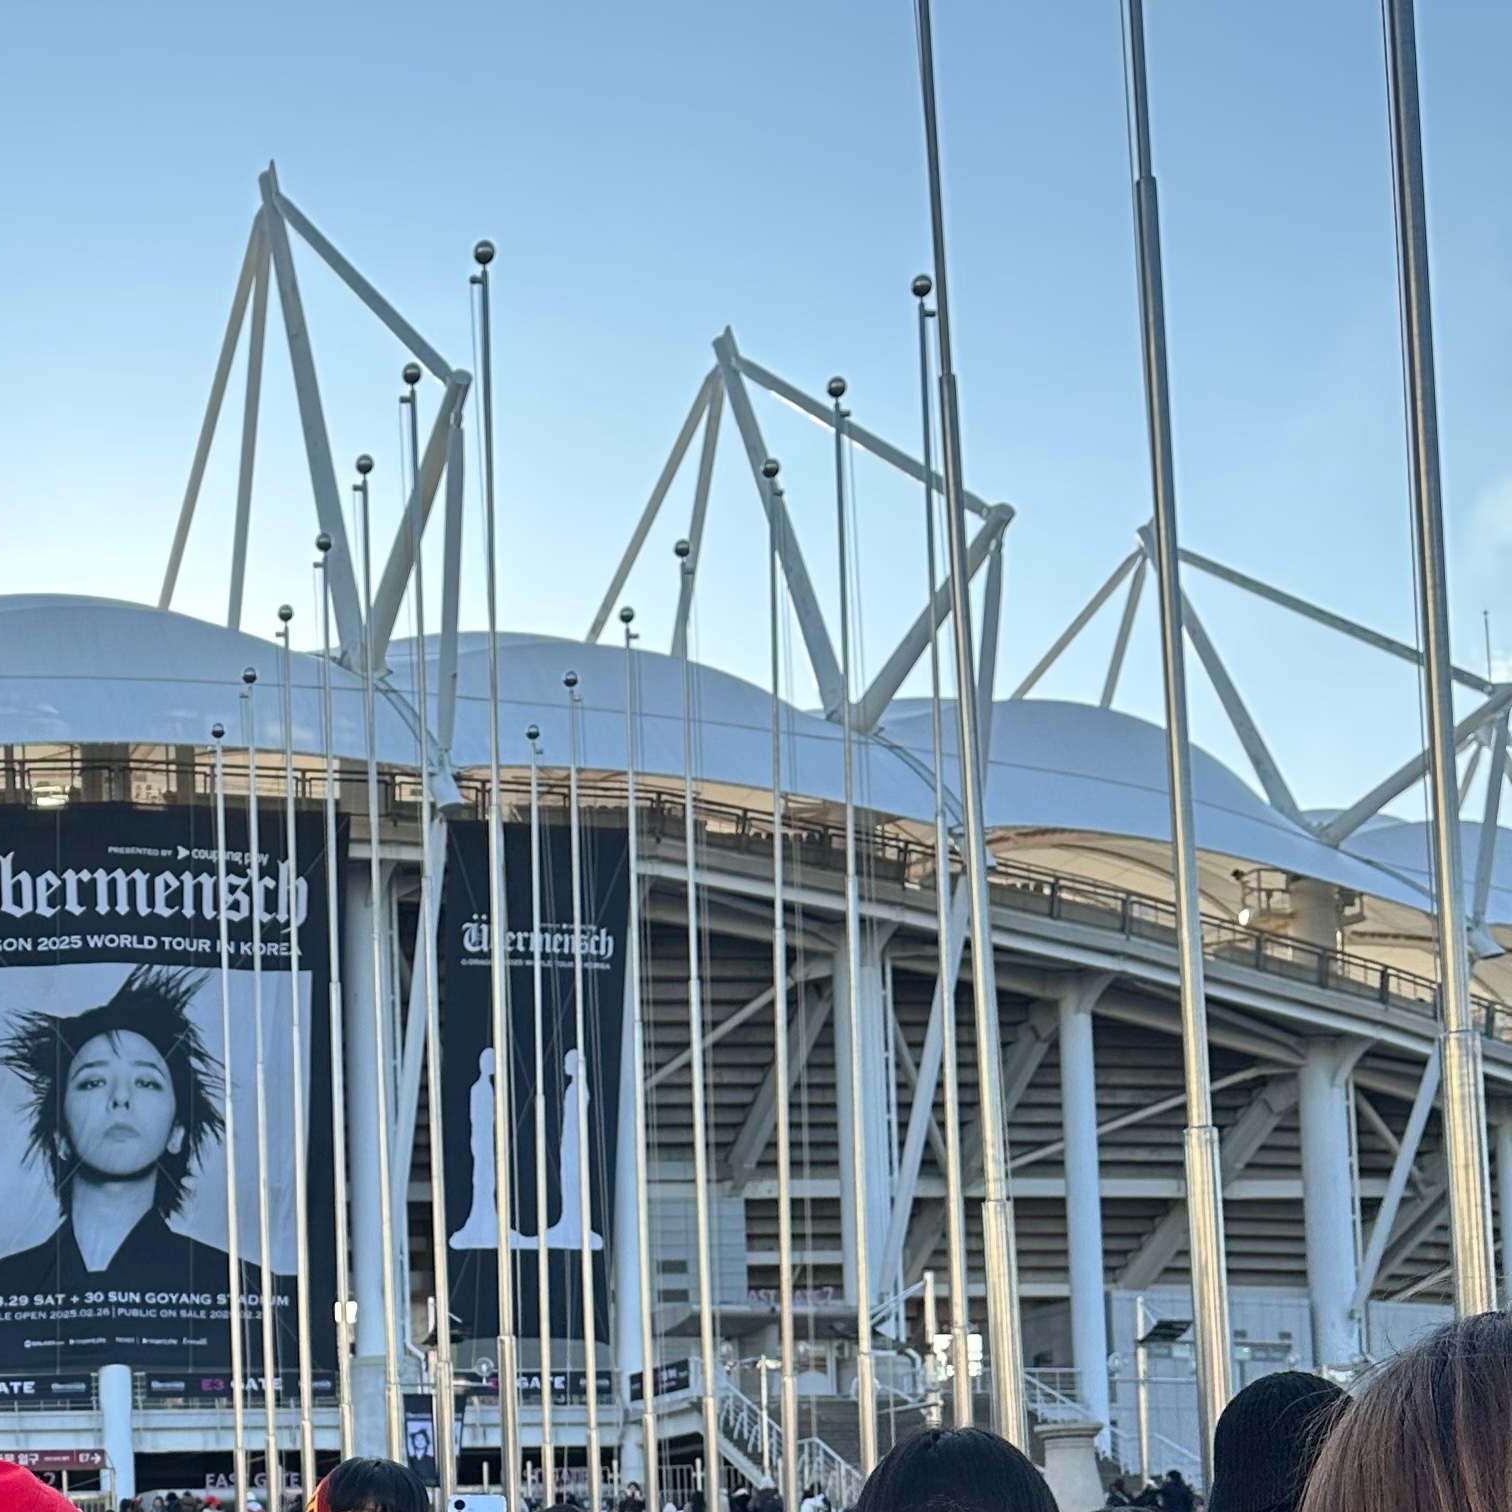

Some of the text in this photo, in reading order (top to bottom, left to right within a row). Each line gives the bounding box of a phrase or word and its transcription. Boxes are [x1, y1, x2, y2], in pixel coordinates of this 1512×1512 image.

[37, 935, 82, 951] 2025
[86, 934, 158, 949] WORLD
[160, 936, 211, 952] TOUR
[461, 913, 614, 960] Üermensch
[33, 1293, 66, 1306] SAT
[84, 1291, 104, 1303] 30
[108, 1291, 140, 1303] SUN
[145, 1292, 212, 1305] GOYANG
[14, 1310, 47, 1321] OPEN
[117, 1308, 158, 1318] PUBLIC
[159, 1309, 177, 1318] ON
[179, 1309, 206, 1319] SALE
[201, 1378, 225, 1391] E3
